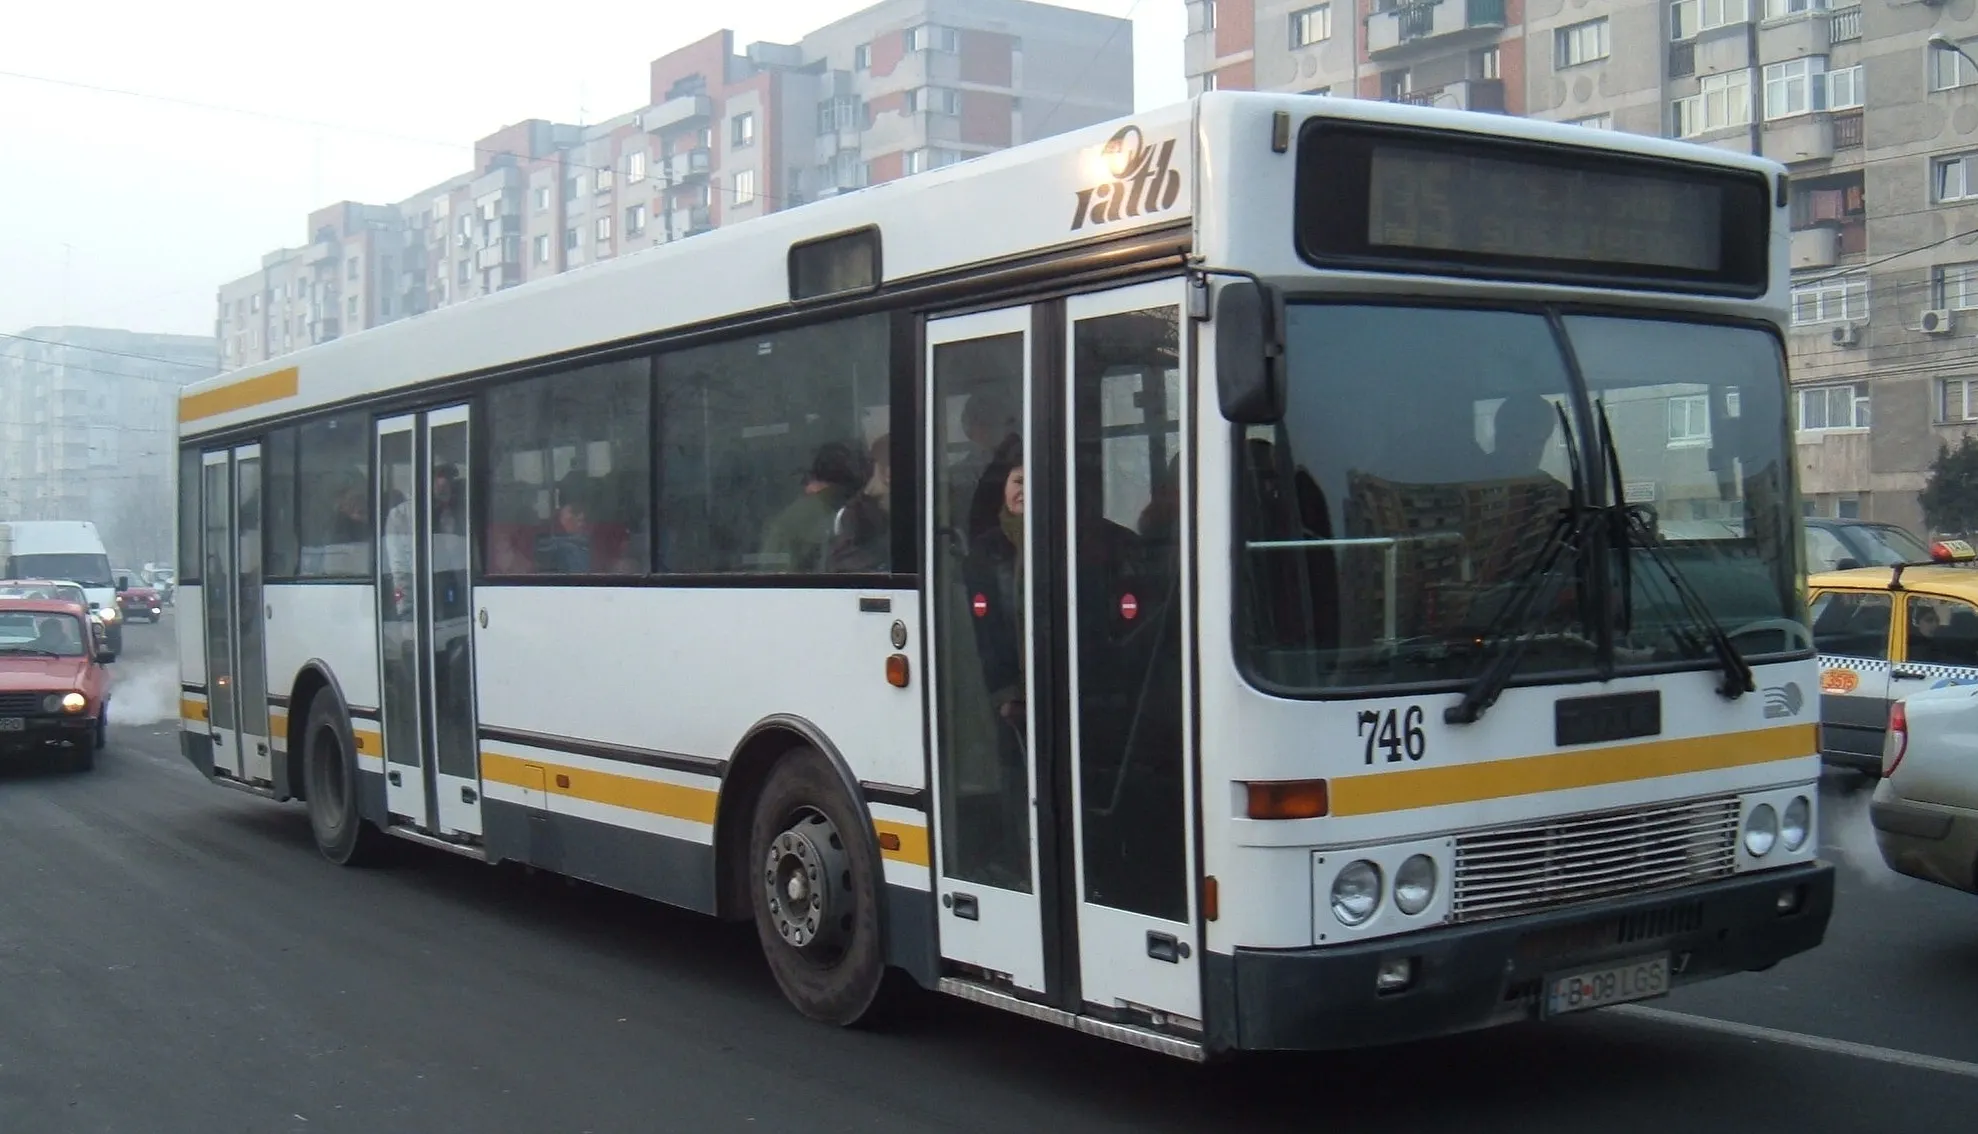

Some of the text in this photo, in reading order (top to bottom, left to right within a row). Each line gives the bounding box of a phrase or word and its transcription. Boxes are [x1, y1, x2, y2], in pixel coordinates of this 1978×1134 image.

[1357, 705, 1425, 765] 746
[1568, 977, 1583, 1006] B
[1621, 962, 1663, 996] LGS
